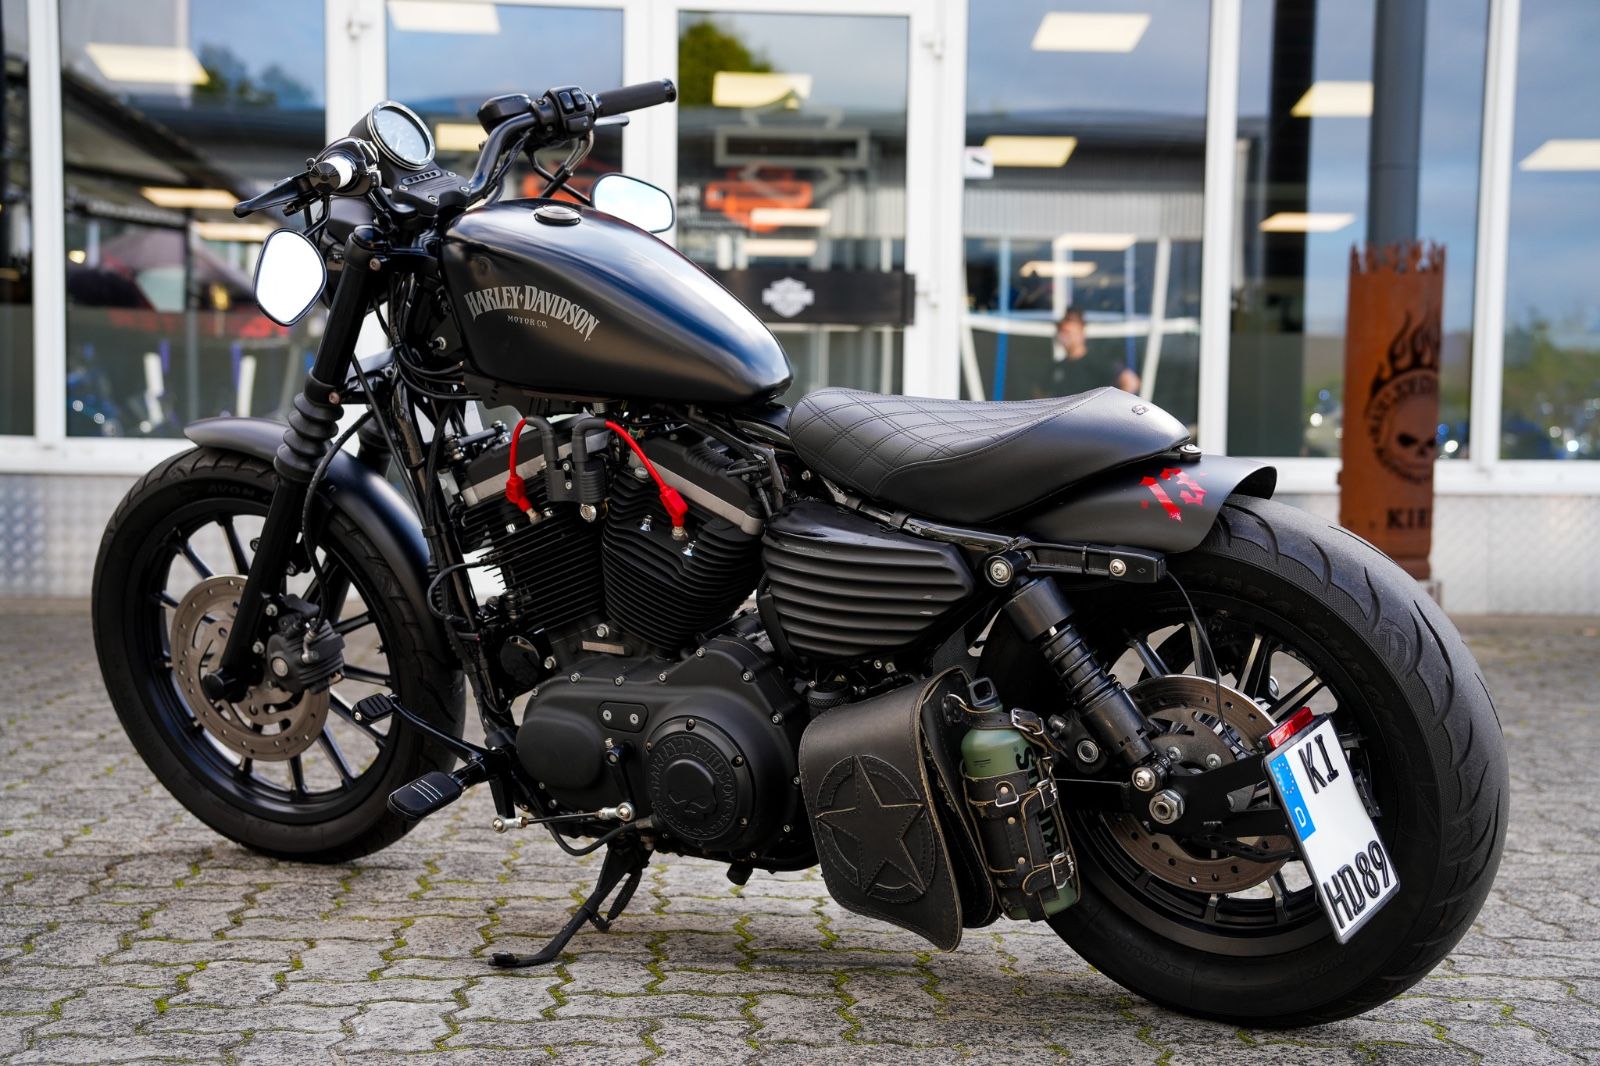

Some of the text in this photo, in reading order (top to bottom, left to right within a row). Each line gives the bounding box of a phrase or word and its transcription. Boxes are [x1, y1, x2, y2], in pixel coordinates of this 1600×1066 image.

[507, 315, 535, 326] MOTOR
[1298, 733, 1340, 794] KI
[1294, 806, 1308, 828] D
